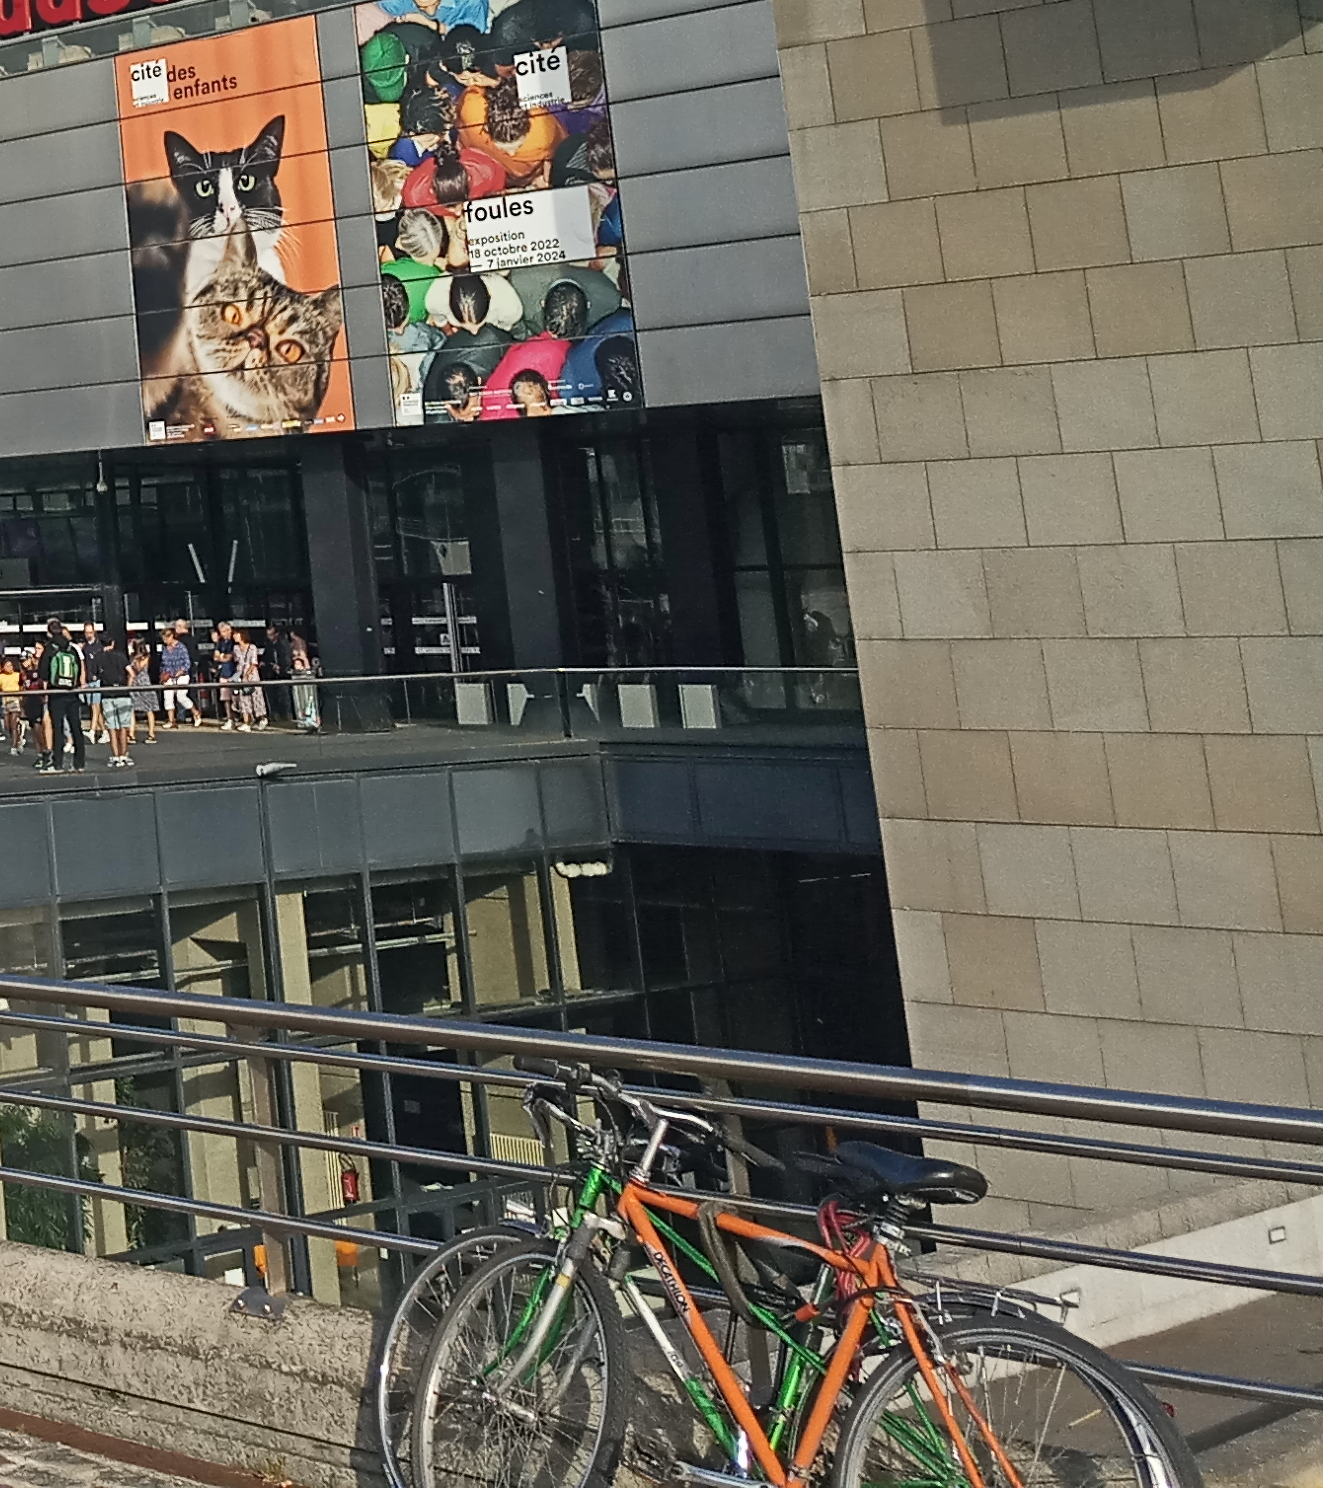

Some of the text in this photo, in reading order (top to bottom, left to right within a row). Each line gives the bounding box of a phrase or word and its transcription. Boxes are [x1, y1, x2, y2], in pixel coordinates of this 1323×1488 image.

[131, 59, 196, 83] cité des
[516, 47, 560, 76] cité
[174, 75, 237, 99] enfants
[463, 197, 533, 223] foules
[468, 231, 525, 246] exposition
[470, 238, 560, 259] 18 octobre 2022
[487, 259, 494, 268] 7
[496, 254, 534, 269] janvier
[537, 250, 566, 263] 2024
